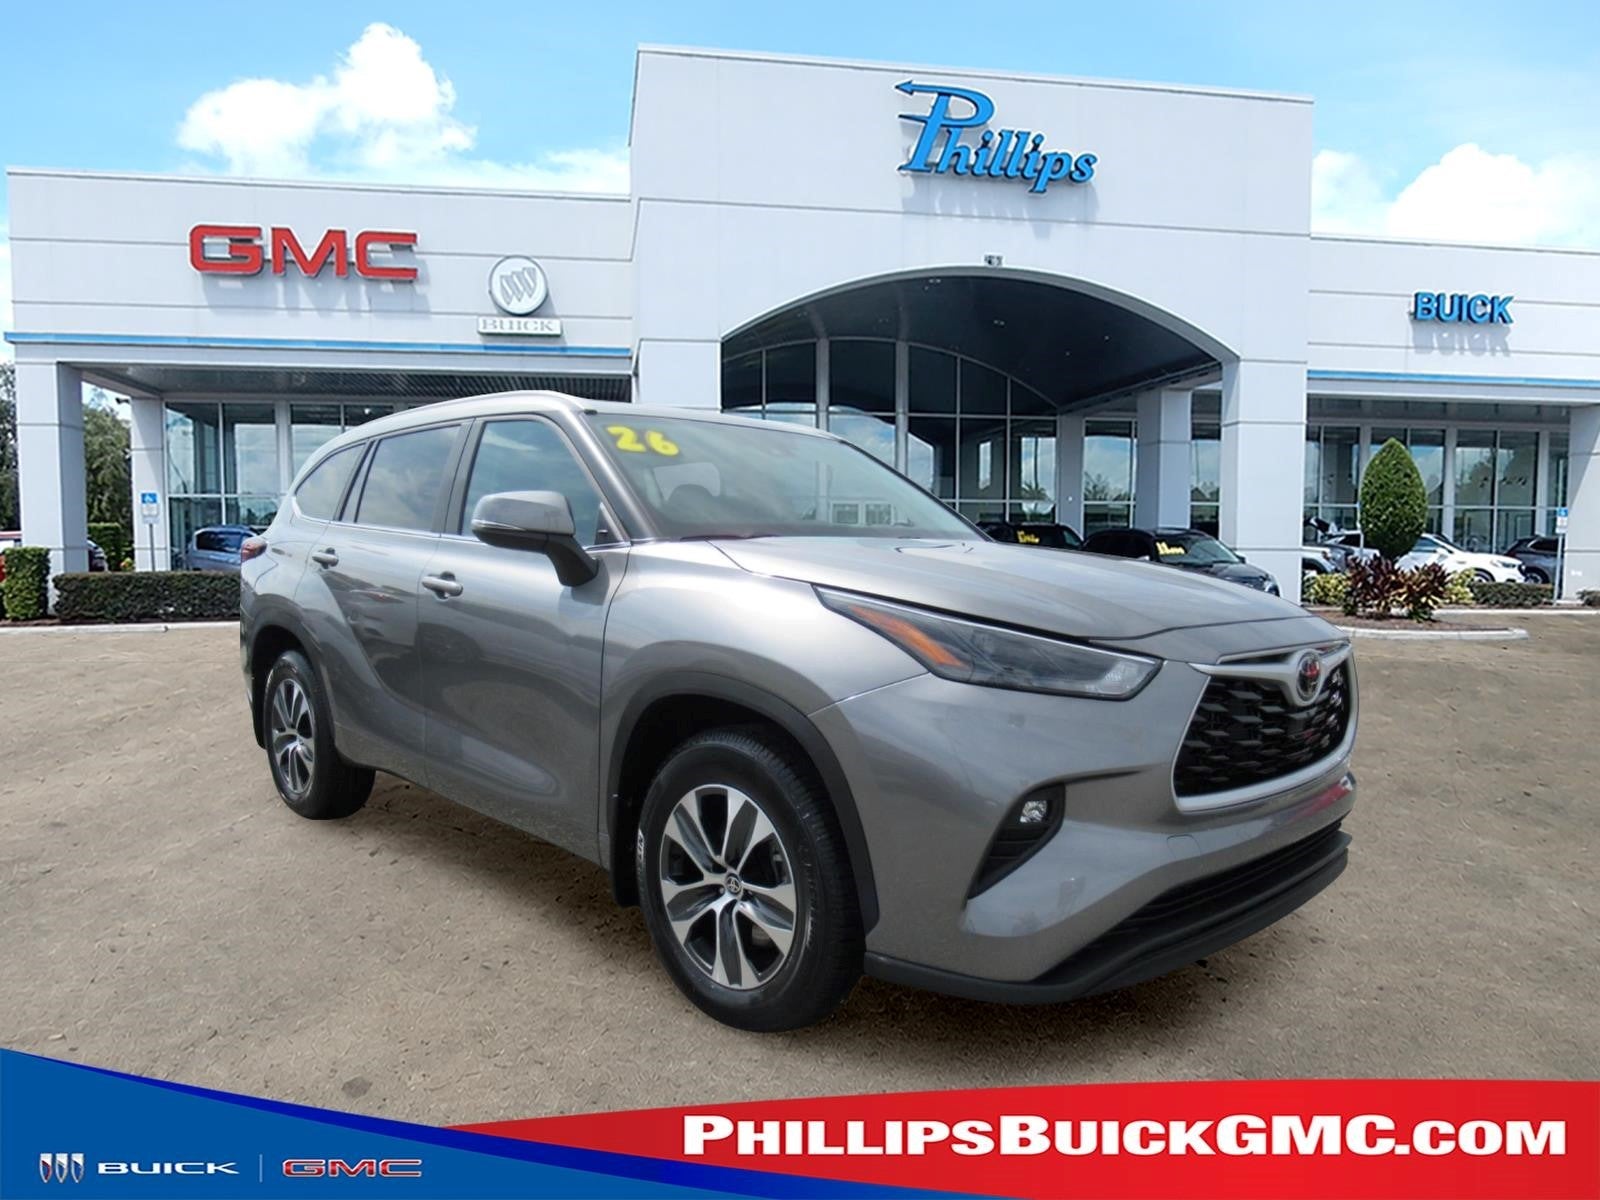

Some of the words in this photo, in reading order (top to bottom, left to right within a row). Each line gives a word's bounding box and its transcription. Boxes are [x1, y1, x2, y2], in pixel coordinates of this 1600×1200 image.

[895, 80, 1098, 193] Phillips
[189, 224, 418, 281] GMC
[1414, 292, 1514, 324] BUICK
[482, 319, 554, 332] BUICK
[606, 424, 679, 456] 26
